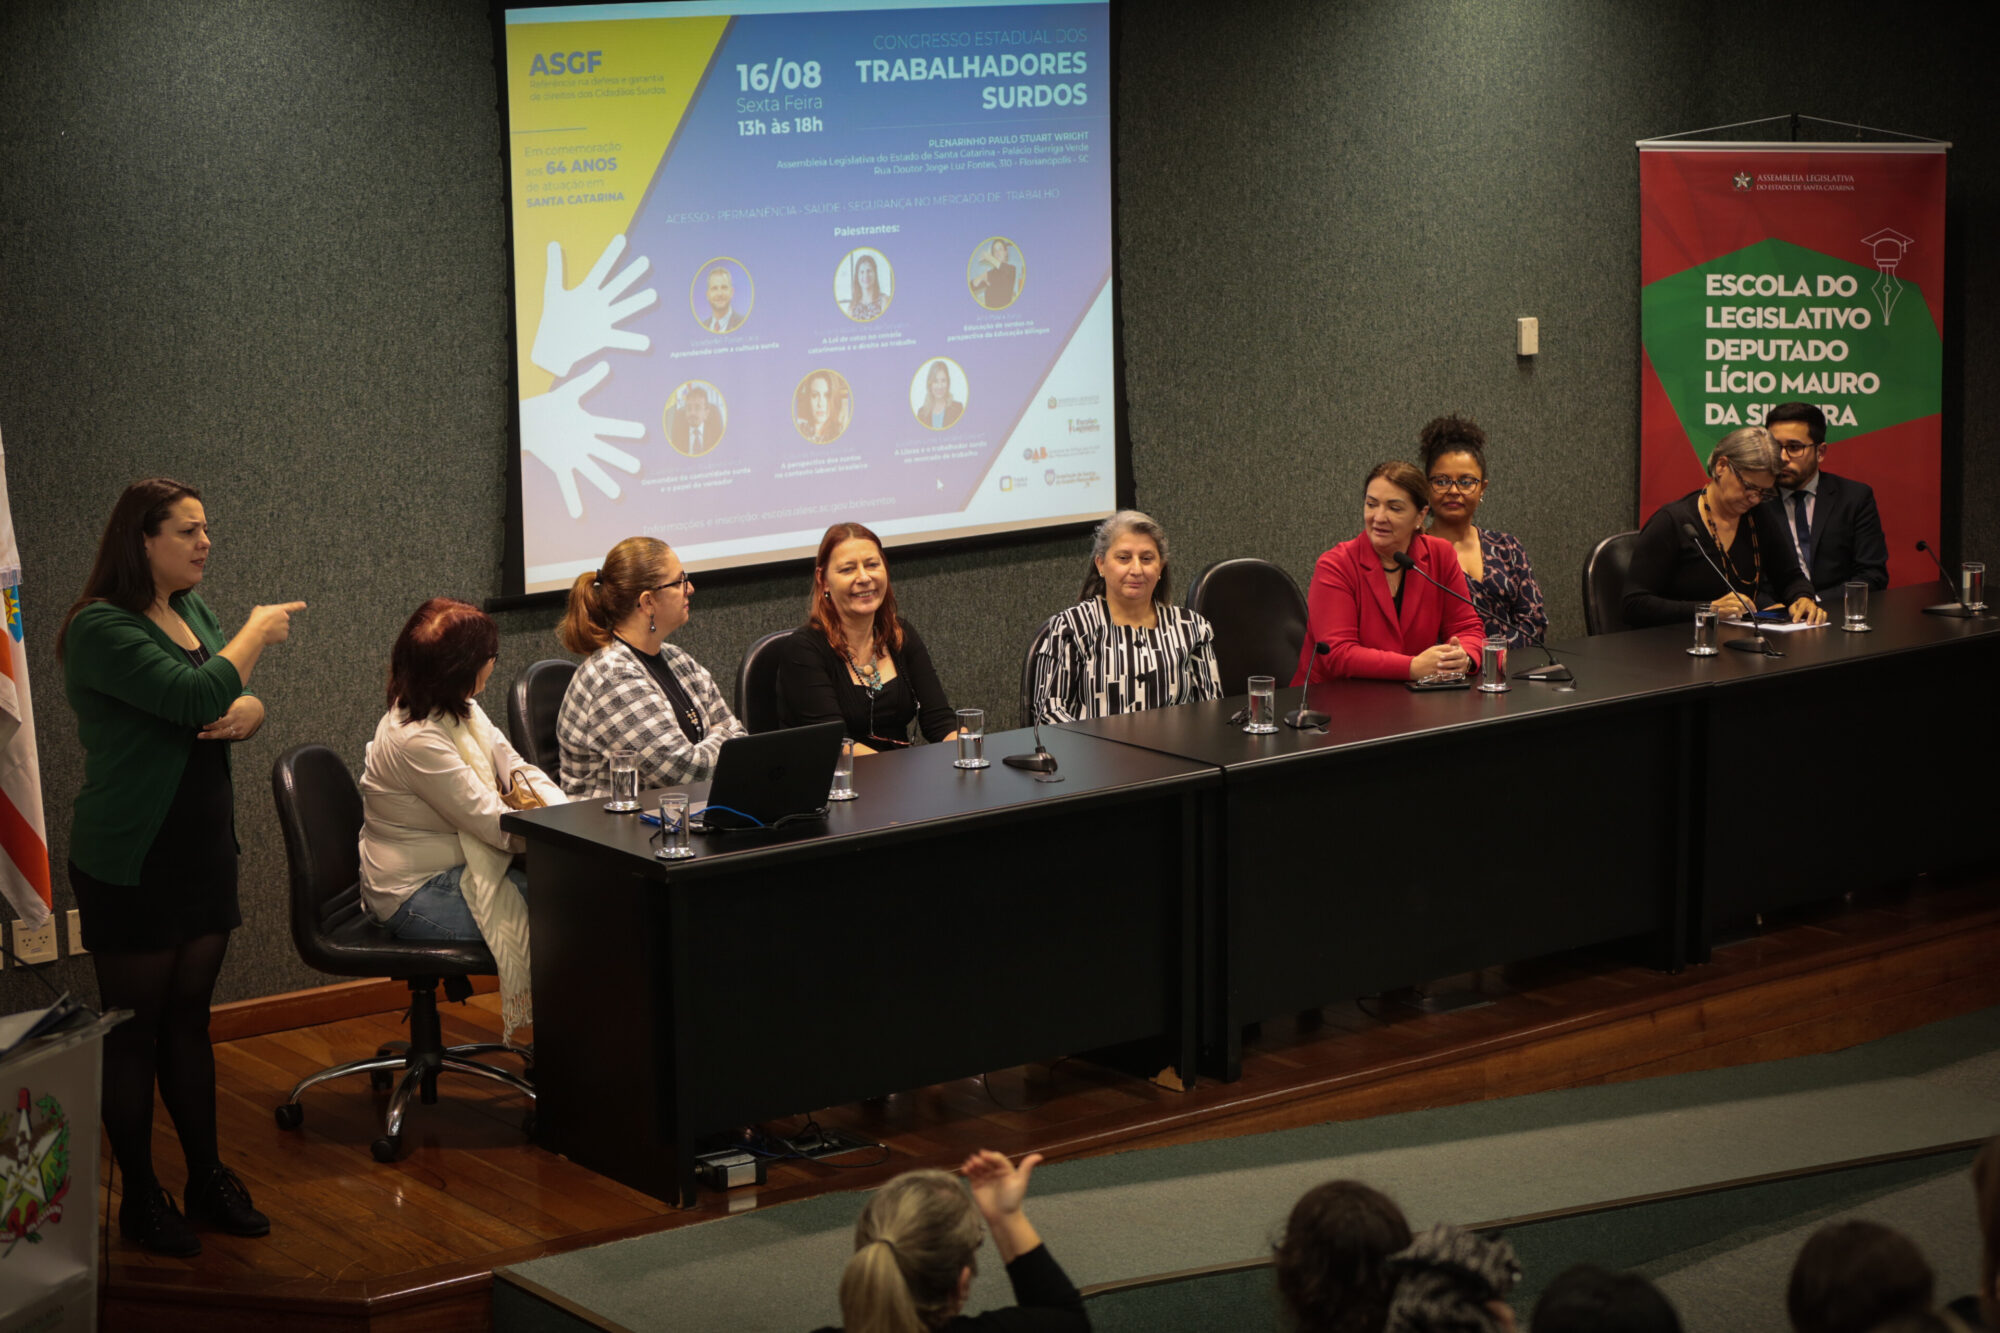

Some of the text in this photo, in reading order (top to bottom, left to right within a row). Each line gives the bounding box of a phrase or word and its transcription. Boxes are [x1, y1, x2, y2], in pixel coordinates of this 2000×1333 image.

[873, 27, 1088, 50] CONGRESSO ESTADUAL DOS
[529, 50, 602, 76] ASGF
[855, 51, 1088, 83] TRABALHADORES
[736, 57, 822, 94] 16/08
[577, 90, 593, 99] dos
[736, 94, 823, 113] Sexta Feira
[982, 82, 1088, 110] SURDOS
[737, 115, 823, 136] 13h às 18h
[524, 141, 621, 157] Em comemoração
[928, 131, 1089, 148] PLENARINHO PAULO STUART WRIGHT
[546, 160, 567, 175] 64
[571, 157, 617, 173] ANOS
[776, 156, 827, 169] Assembleia
[829, 154, 875, 168] Legislativa
[877, 152, 888, 163] do
[890, 151, 919, 162] Estado
[921, 150, 932, 160] de
[934, 149, 958, 160] Santa
[960, 147, 996, 158] Catarina
[874, 166, 891, 175] Rua
[893, 164, 923, 174] Doutor
[924, 162, 949, 174] Jorge
[1078, 153, 1089, 163] SC
[1757, 174, 1855, 182] ASSEMBLEIA LEGISLATIVA
[1823, 184, 1855, 192] CATARINA
[526, 191, 625, 208] SANTA CATARINA
[665, 211, 710, 224] ACESSO
[847, 197, 913, 210] SEGURANÇA
[914, 196, 931, 207] NO
[932, 193, 985, 206] MERCADO
[987, 191, 1002, 203] DE
[1006, 188, 1060, 201] TRABALHO
[833, 224, 900, 237] Palestrantes:
[1706, 274, 1858, 297] ESCOLA DO
[1706, 306, 1872, 330] LEGISLATIVO
[1705, 338, 1849, 362] DEPUTADO
[1705, 364, 1880, 394] LÍCIO MAURO
[1705, 403, 1742, 425] DA
